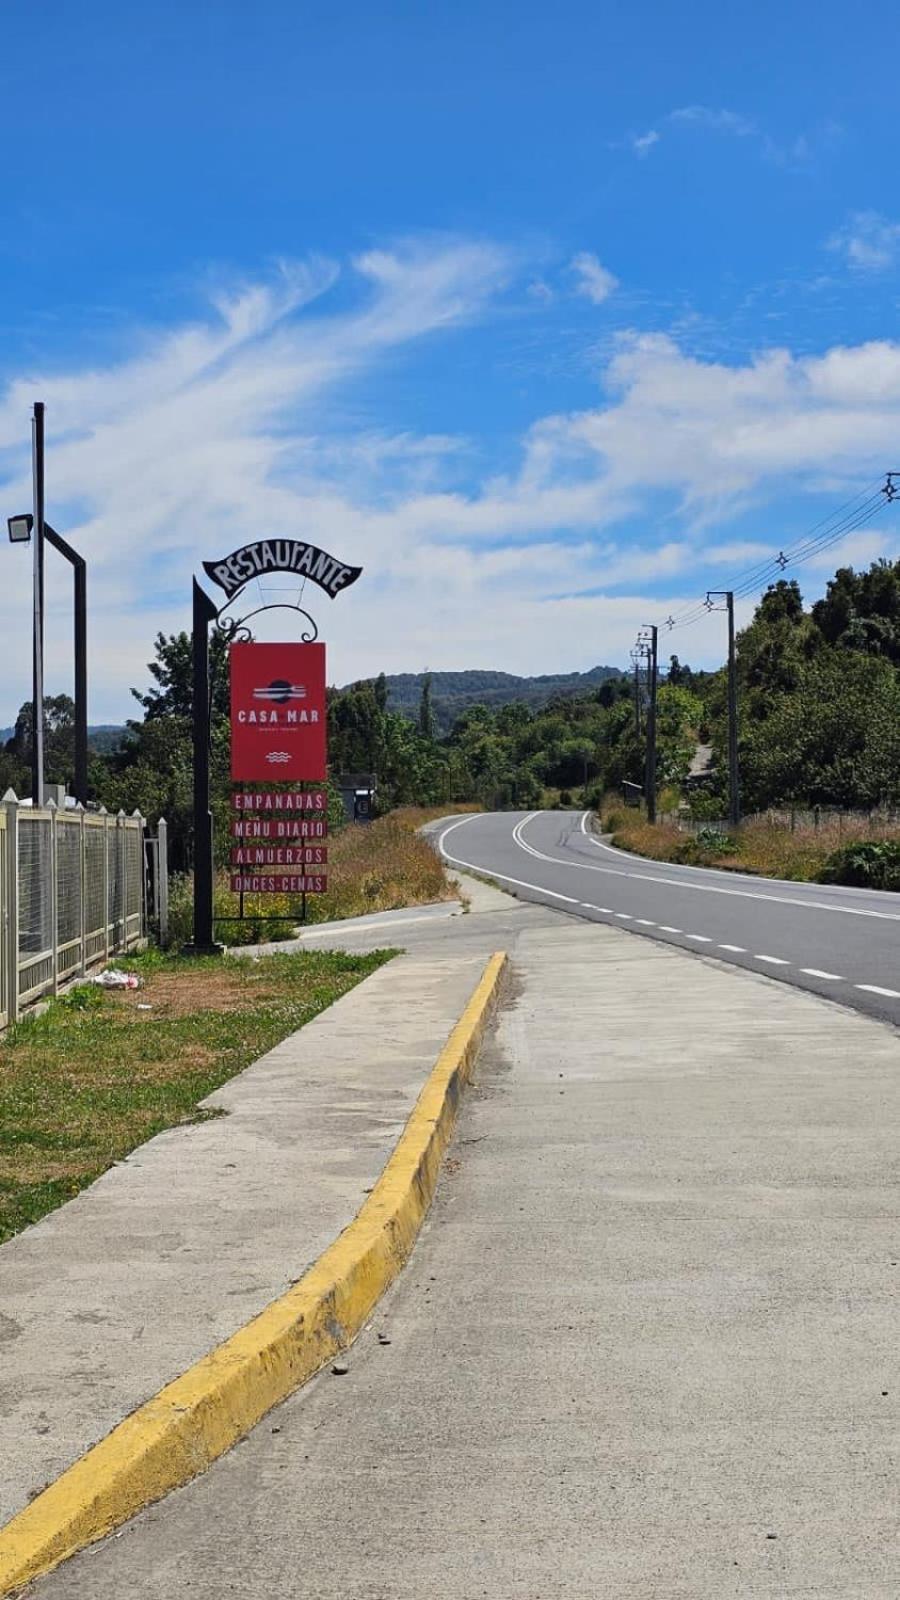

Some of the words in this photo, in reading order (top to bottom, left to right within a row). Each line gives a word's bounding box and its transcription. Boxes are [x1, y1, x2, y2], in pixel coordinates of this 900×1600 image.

[238, 710, 278, 723] CASA
[287, 710, 319, 723] MAR
[235, 794, 323, 809] EMPANADAS
[277, 821, 323, 836] DIARIO
[236, 848, 323, 863] ALMUERZOS
